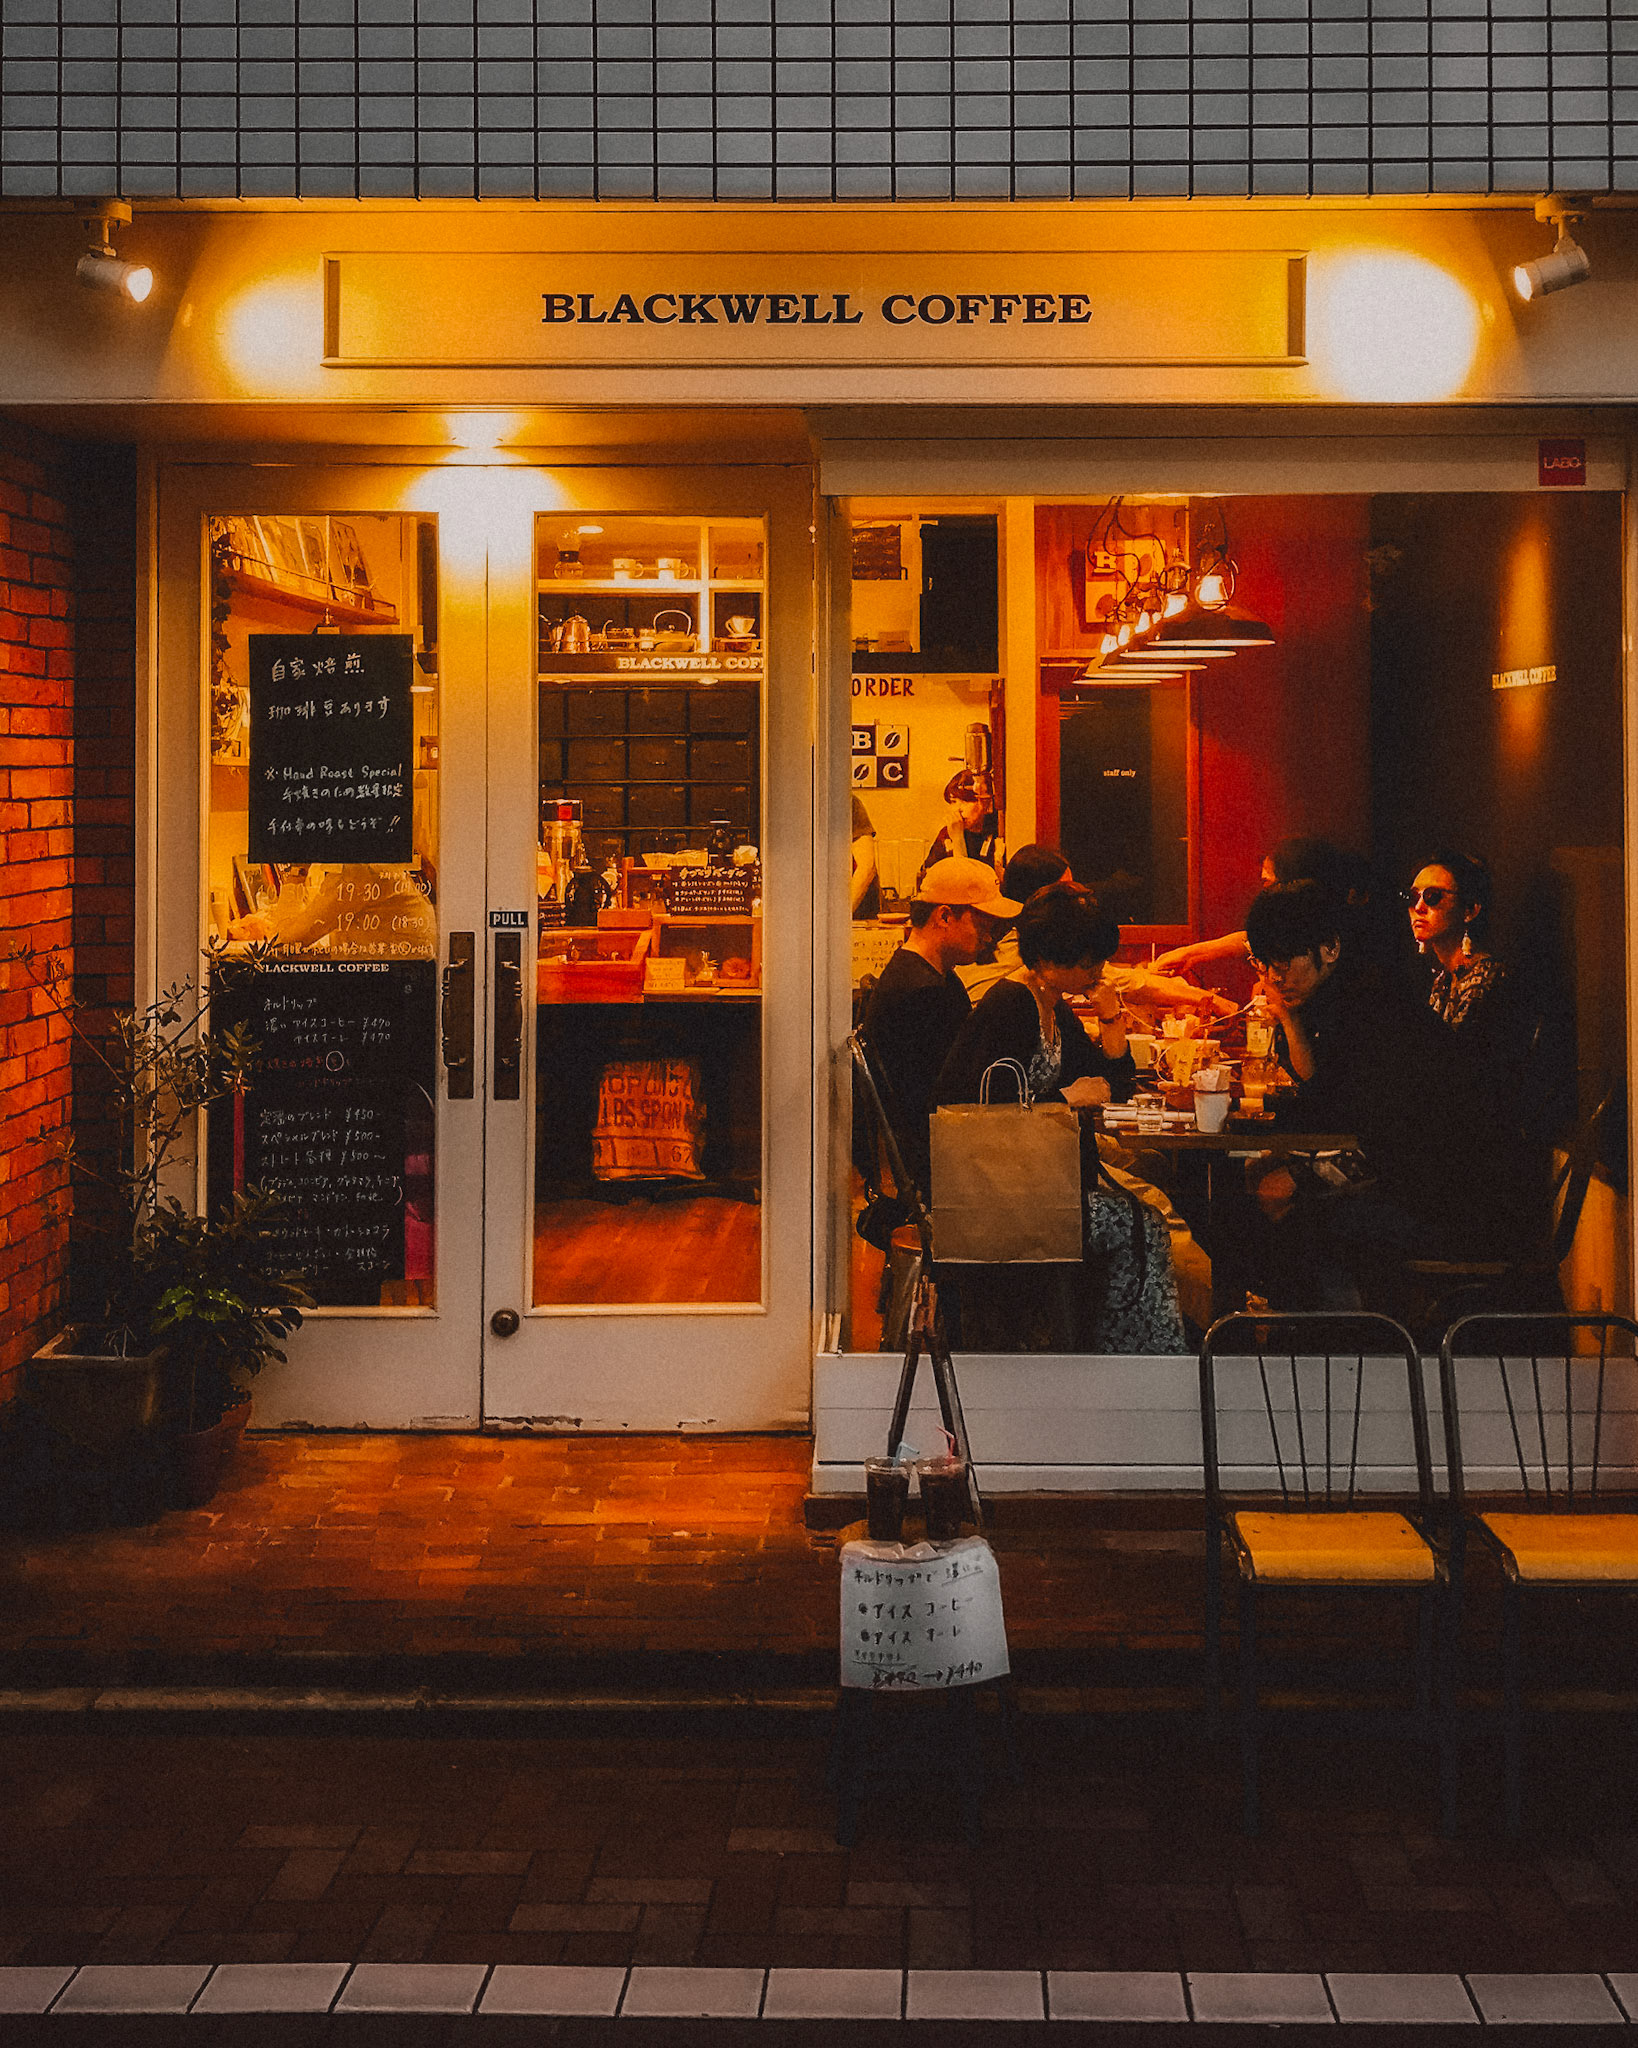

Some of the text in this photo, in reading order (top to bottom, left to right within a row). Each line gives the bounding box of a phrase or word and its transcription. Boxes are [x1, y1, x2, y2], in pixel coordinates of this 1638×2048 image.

[542, 294, 1093, 324] BLACKWELL COFFEE
[617, 657, 722, 670] BLACKWELL
[851, 677, 915, 698] ORDER
[283, 766, 314, 780] Hand
[320, 765, 354, 779] Roast
[361, 763, 402, 779] Special
[882, 763, 903, 781] C
[1103, 768, 1136, 778] staff only
[337, 911, 381, 932] 19:00
[493, 913, 525, 926] PULL
[261, 963, 390, 974] LACKWELL COFFEE
